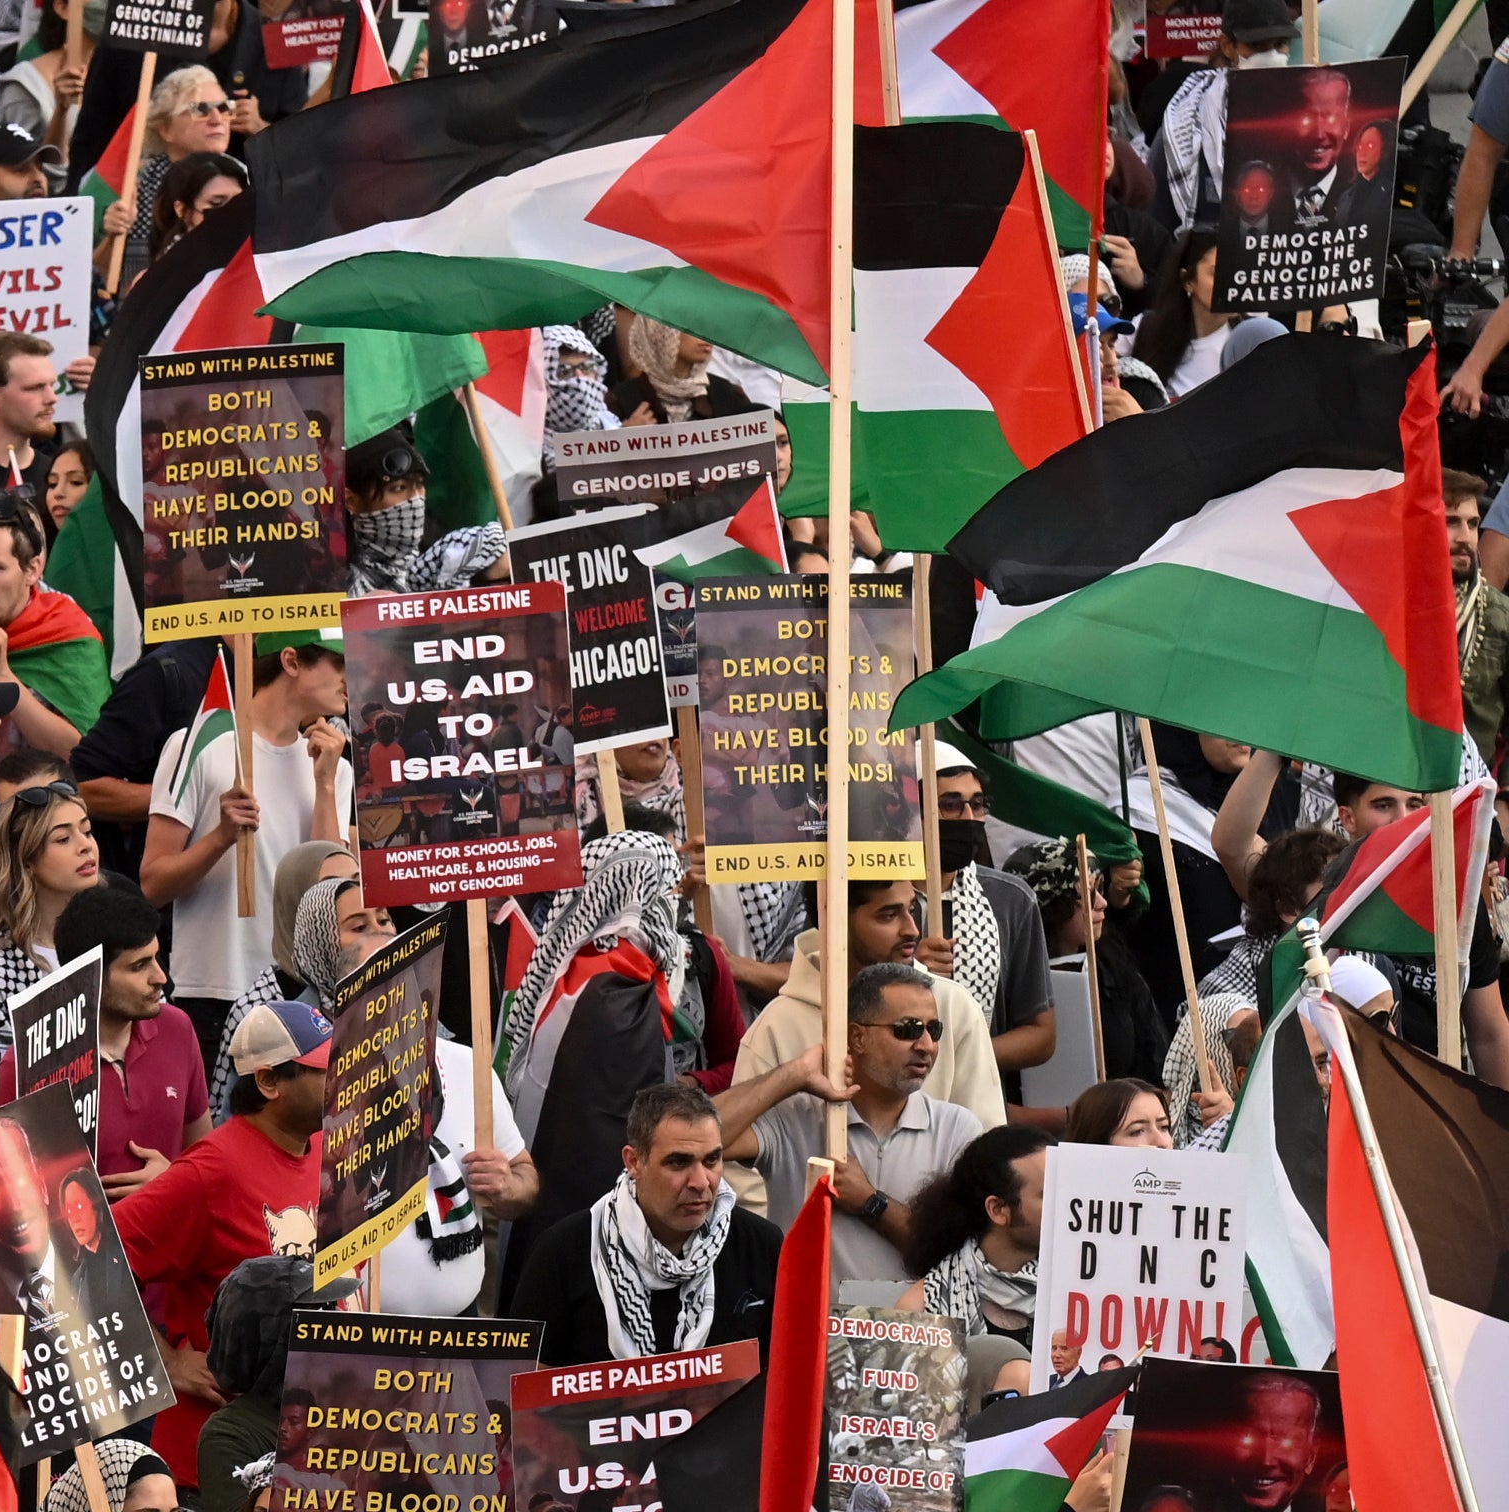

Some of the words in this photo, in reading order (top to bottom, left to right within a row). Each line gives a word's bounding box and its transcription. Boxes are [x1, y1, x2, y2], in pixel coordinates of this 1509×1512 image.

[1245, 224, 1368, 250] DEMOCRATS
[1257, 250, 1313, 266] FUND
[1324, 244, 1355, 260] THE
[1234, 264, 1340, 284] GENOCIDE
[1349, 258, 1372, 273] OF
[1228, 274, 1374, 302] PALESTINIANS
[145, 364, 195, 380] STAND
[201, 358, 242, 373] WITH
[247, 353, 335, 370] PALESTINE
[208, 390, 272, 412] BOTH
[162, 422, 298, 450] DEMOCRATS
[308, 421, 322, 438] &
[563, 439, 620, 457] STAND
[627, 431, 672, 451] WITH
[677, 421, 768, 446] PALESTINE
[166, 454, 320, 482] REPUBLICANS
[573, 471, 691, 496] GENOCIDE
[698, 459, 761, 479] JOE'S
[154, 495, 206, 518] HAVE
[215, 490, 293, 512] BLOOD
[301, 487, 334, 504] ON
[169, 528, 228, 550] THEIR
[237, 522, 320, 543] HANDS!
[152, 617, 179, 630] END
[185, 613, 211, 626] U.S.
[219, 610, 243, 624] AID
[251, 608, 273, 621] TO
[281, 604, 337, 618] ISRAEL
[378, 601, 424, 621] FREE
[430, 590, 531, 617] PALESTINE
[413, 635, 505, 664] END
[387, 679, 454, 704] U.S.
[461, 671, 533, 699] AID
[437, 713, 493, 738] TO
[390, 747, 542, 782] ISRAEL
[386, 849, 432, 864] MONEY
[435, 846, 460, 859] FOR
[463, 840, 523, 858] SCHOOLS,
[525, 836, 557, 852] JOBS,
[389, 862, 472, 881] HEALTHCARE,
[476, 862, 485, 873] &
[488, 855, 541, 872] HOUSING
[429, 881, 456, 894] NOT
[459, 874, 523, 891] GENOCIDE!
[1068, 1198, 1142, 1236] SHUT
[1172, 1206, 1231, 1242] THE
[863, 1370, 918, 1390] FUND
[840, 1416, 935, 1440] ISRAEL'S
